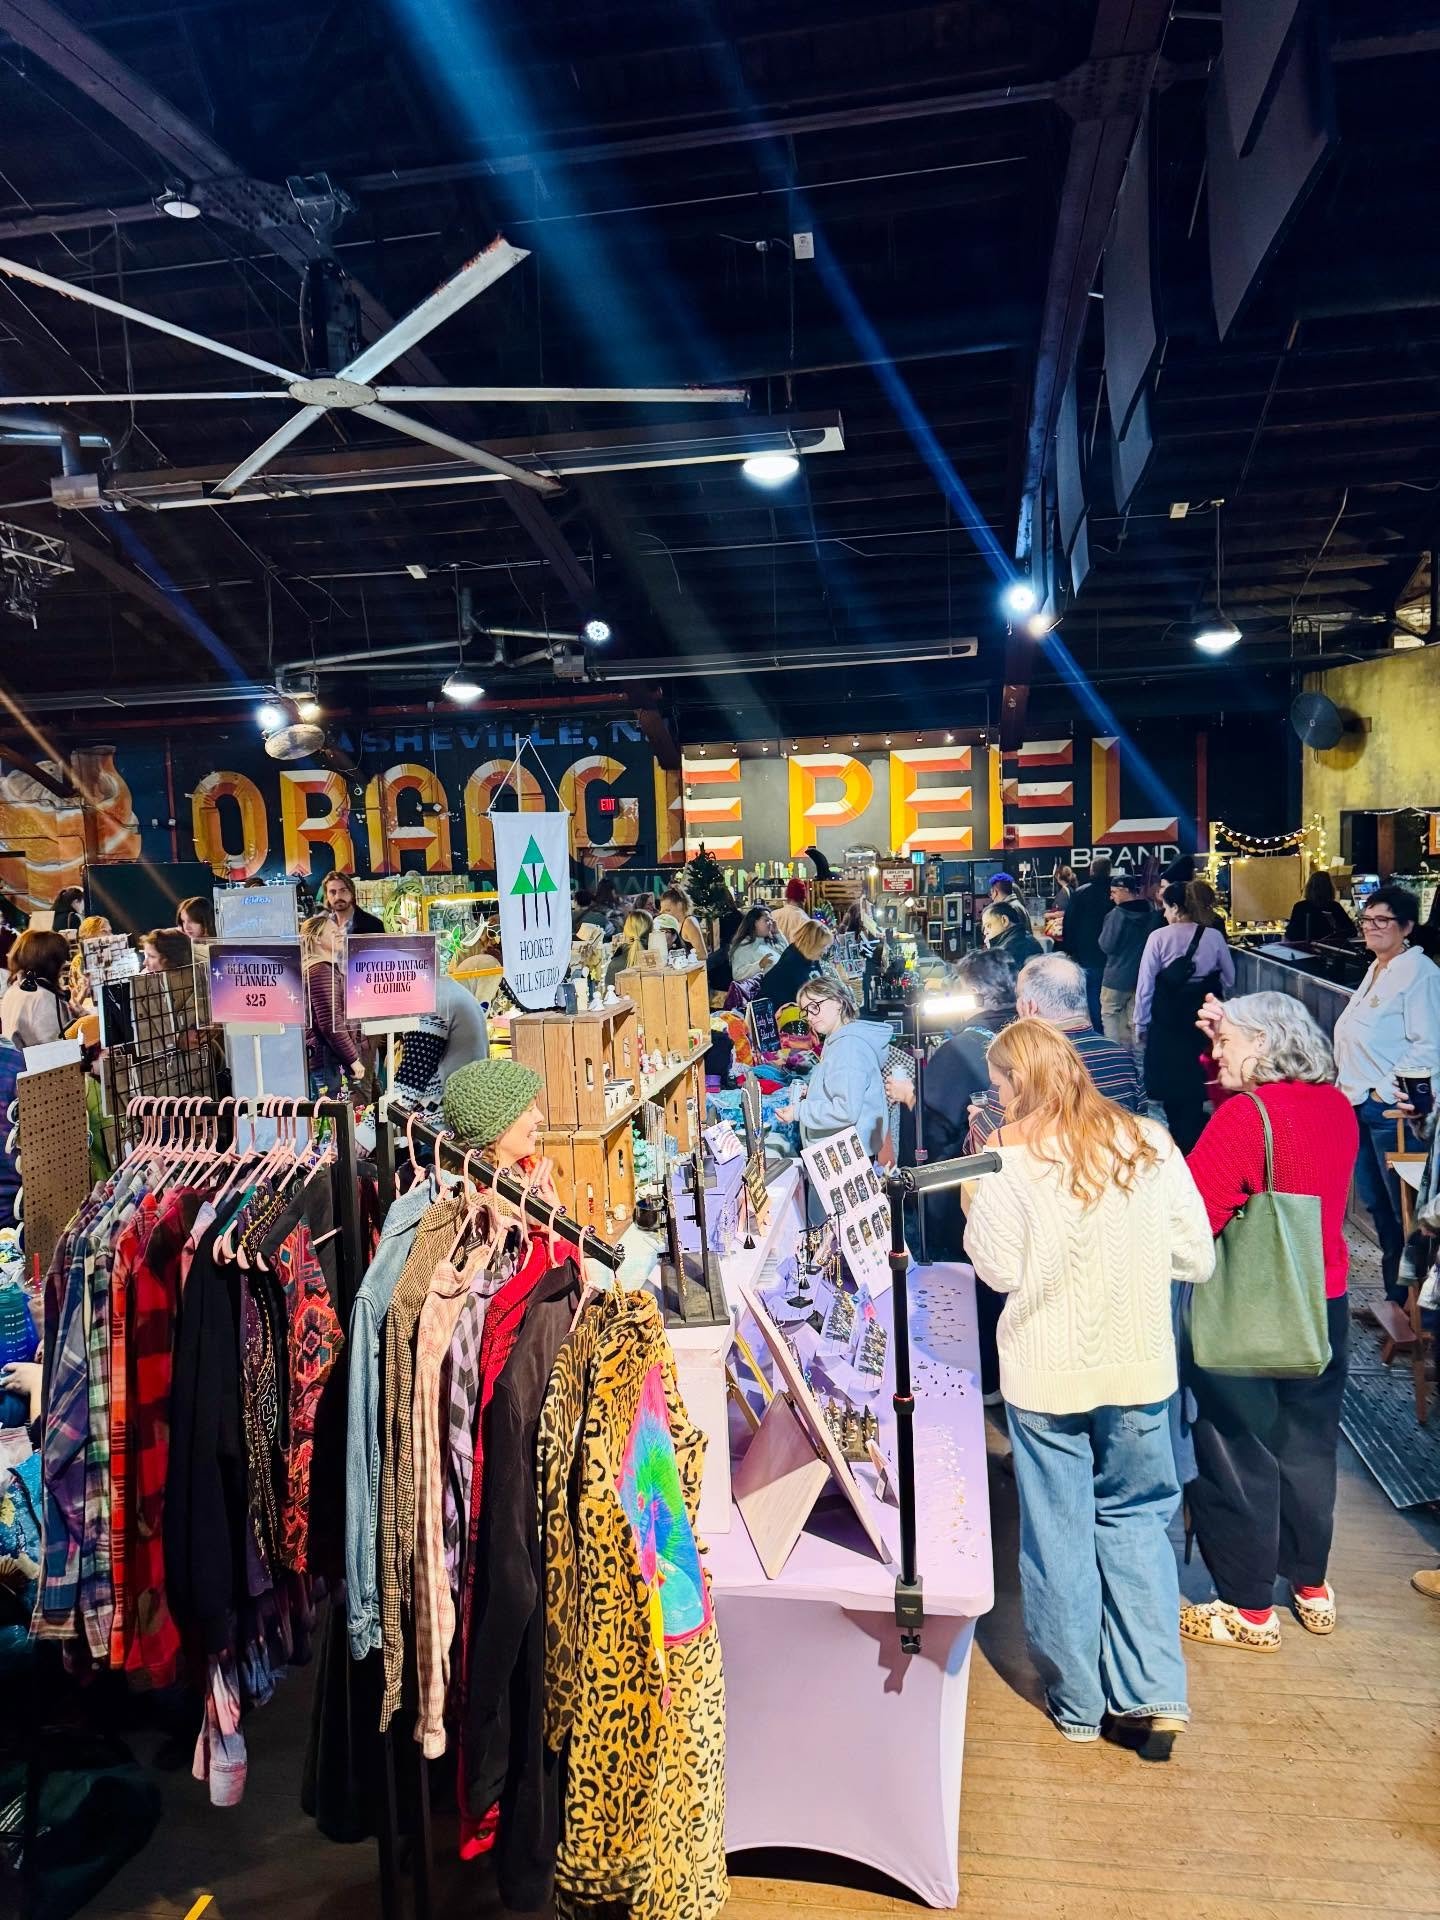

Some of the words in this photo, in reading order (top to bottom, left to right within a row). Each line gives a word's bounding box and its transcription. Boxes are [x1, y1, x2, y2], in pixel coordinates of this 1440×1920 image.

[788, 736, 1179, 858] PEEL
[600, 798, 615, 811] EXIT
[1070, 844, 1180, 868] BRAND
[520, 937, 554, 961] HOOKER
[227, 963, 260, 976] BLEACH
[261, 963, 284, 975] DYED
[355, 961, 396, 973] UPCYCLED
[397, 959, 429, 971] VINTAGE
[235, 975, 277, 987] FLANNELS
[365, 973, 373, 984] &
[373, 971, 396, 983] HAND
[396, 970, 417, 982] DYED
[534, 966, 560, 991] STUDIO
[373, 982, 411, 994] CLOTHING
[246, 993, 267, 1007] $25
